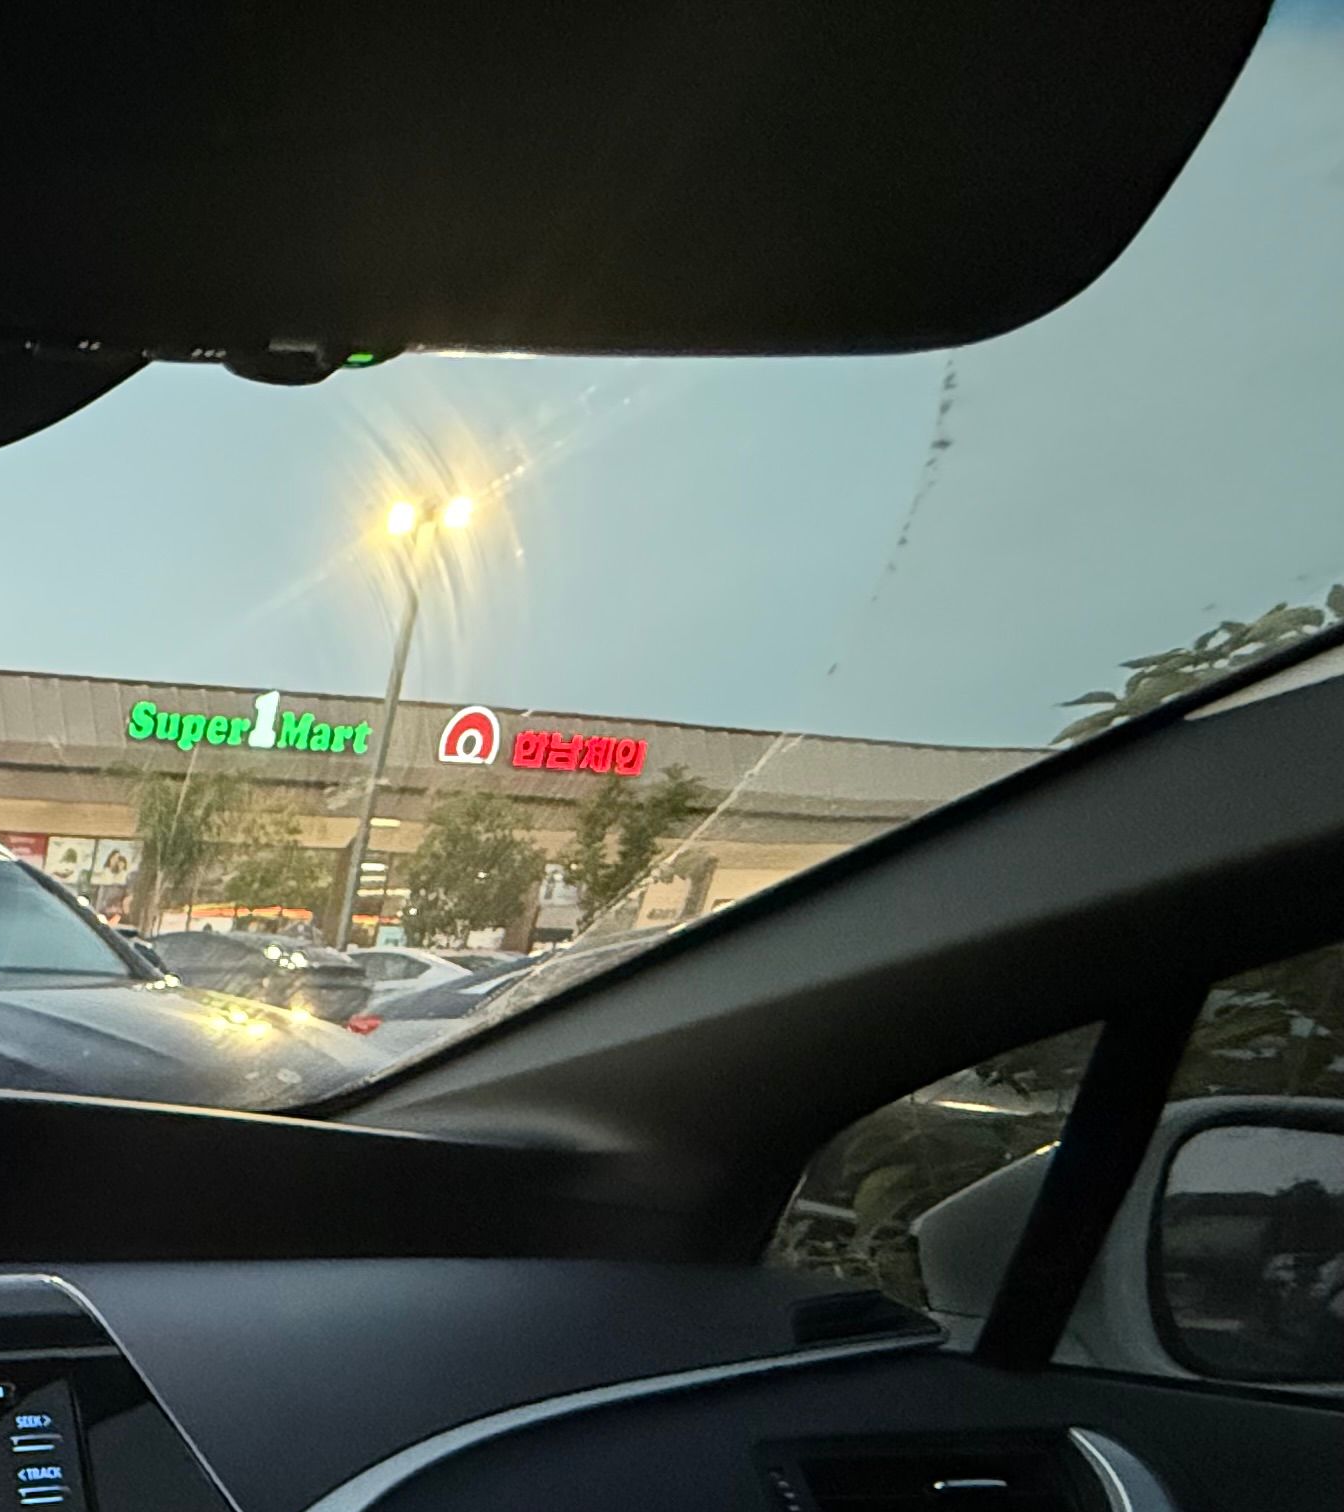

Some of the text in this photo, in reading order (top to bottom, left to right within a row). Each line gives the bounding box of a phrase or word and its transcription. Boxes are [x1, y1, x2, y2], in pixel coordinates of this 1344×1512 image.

[129, 691, 372, 753] Super 1 Mart
[513, 730, 648, 777] 한남체인
